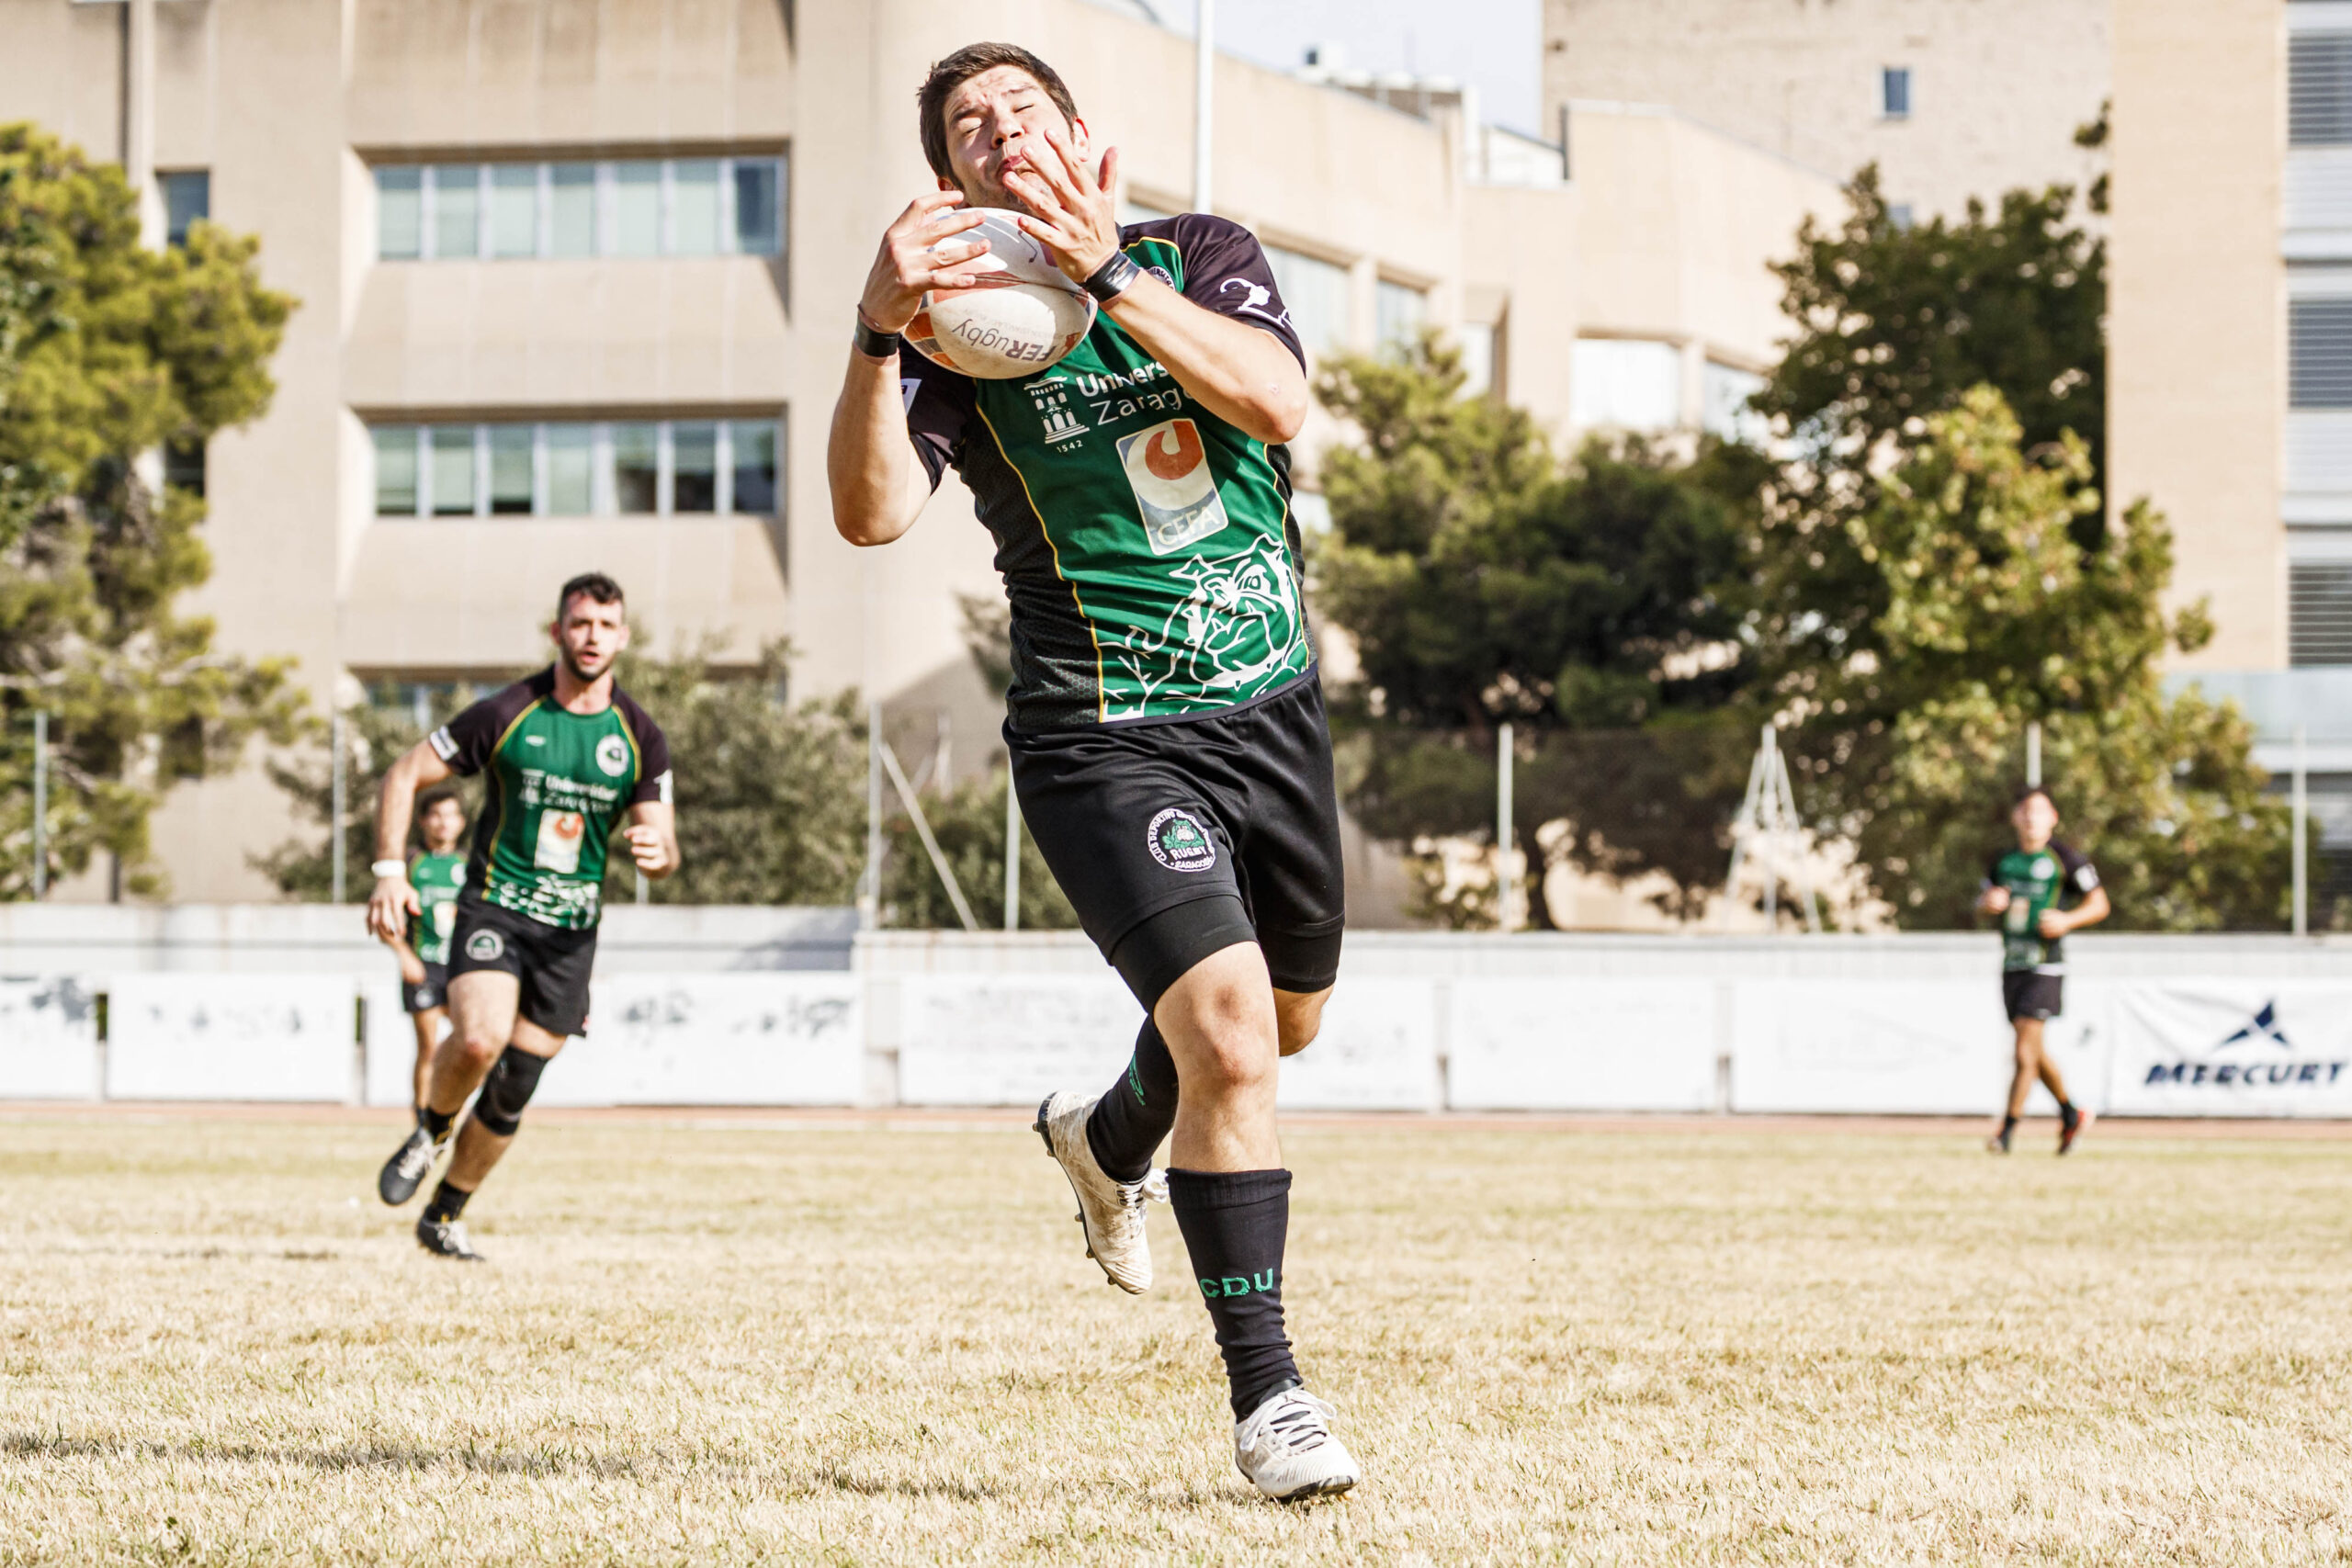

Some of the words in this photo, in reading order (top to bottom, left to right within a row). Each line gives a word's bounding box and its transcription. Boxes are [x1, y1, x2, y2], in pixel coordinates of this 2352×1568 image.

[952, 318, 1057, 362] FERugby
[1076, 361, 1170, 397] Univers
[1057, 439, 1083, 453] 1542
[1158, 506, 1221, 546] CEFA
[1170, 846, 1207, 860] RUGBY
[1199, 1268, 1273, 1298] CDU
